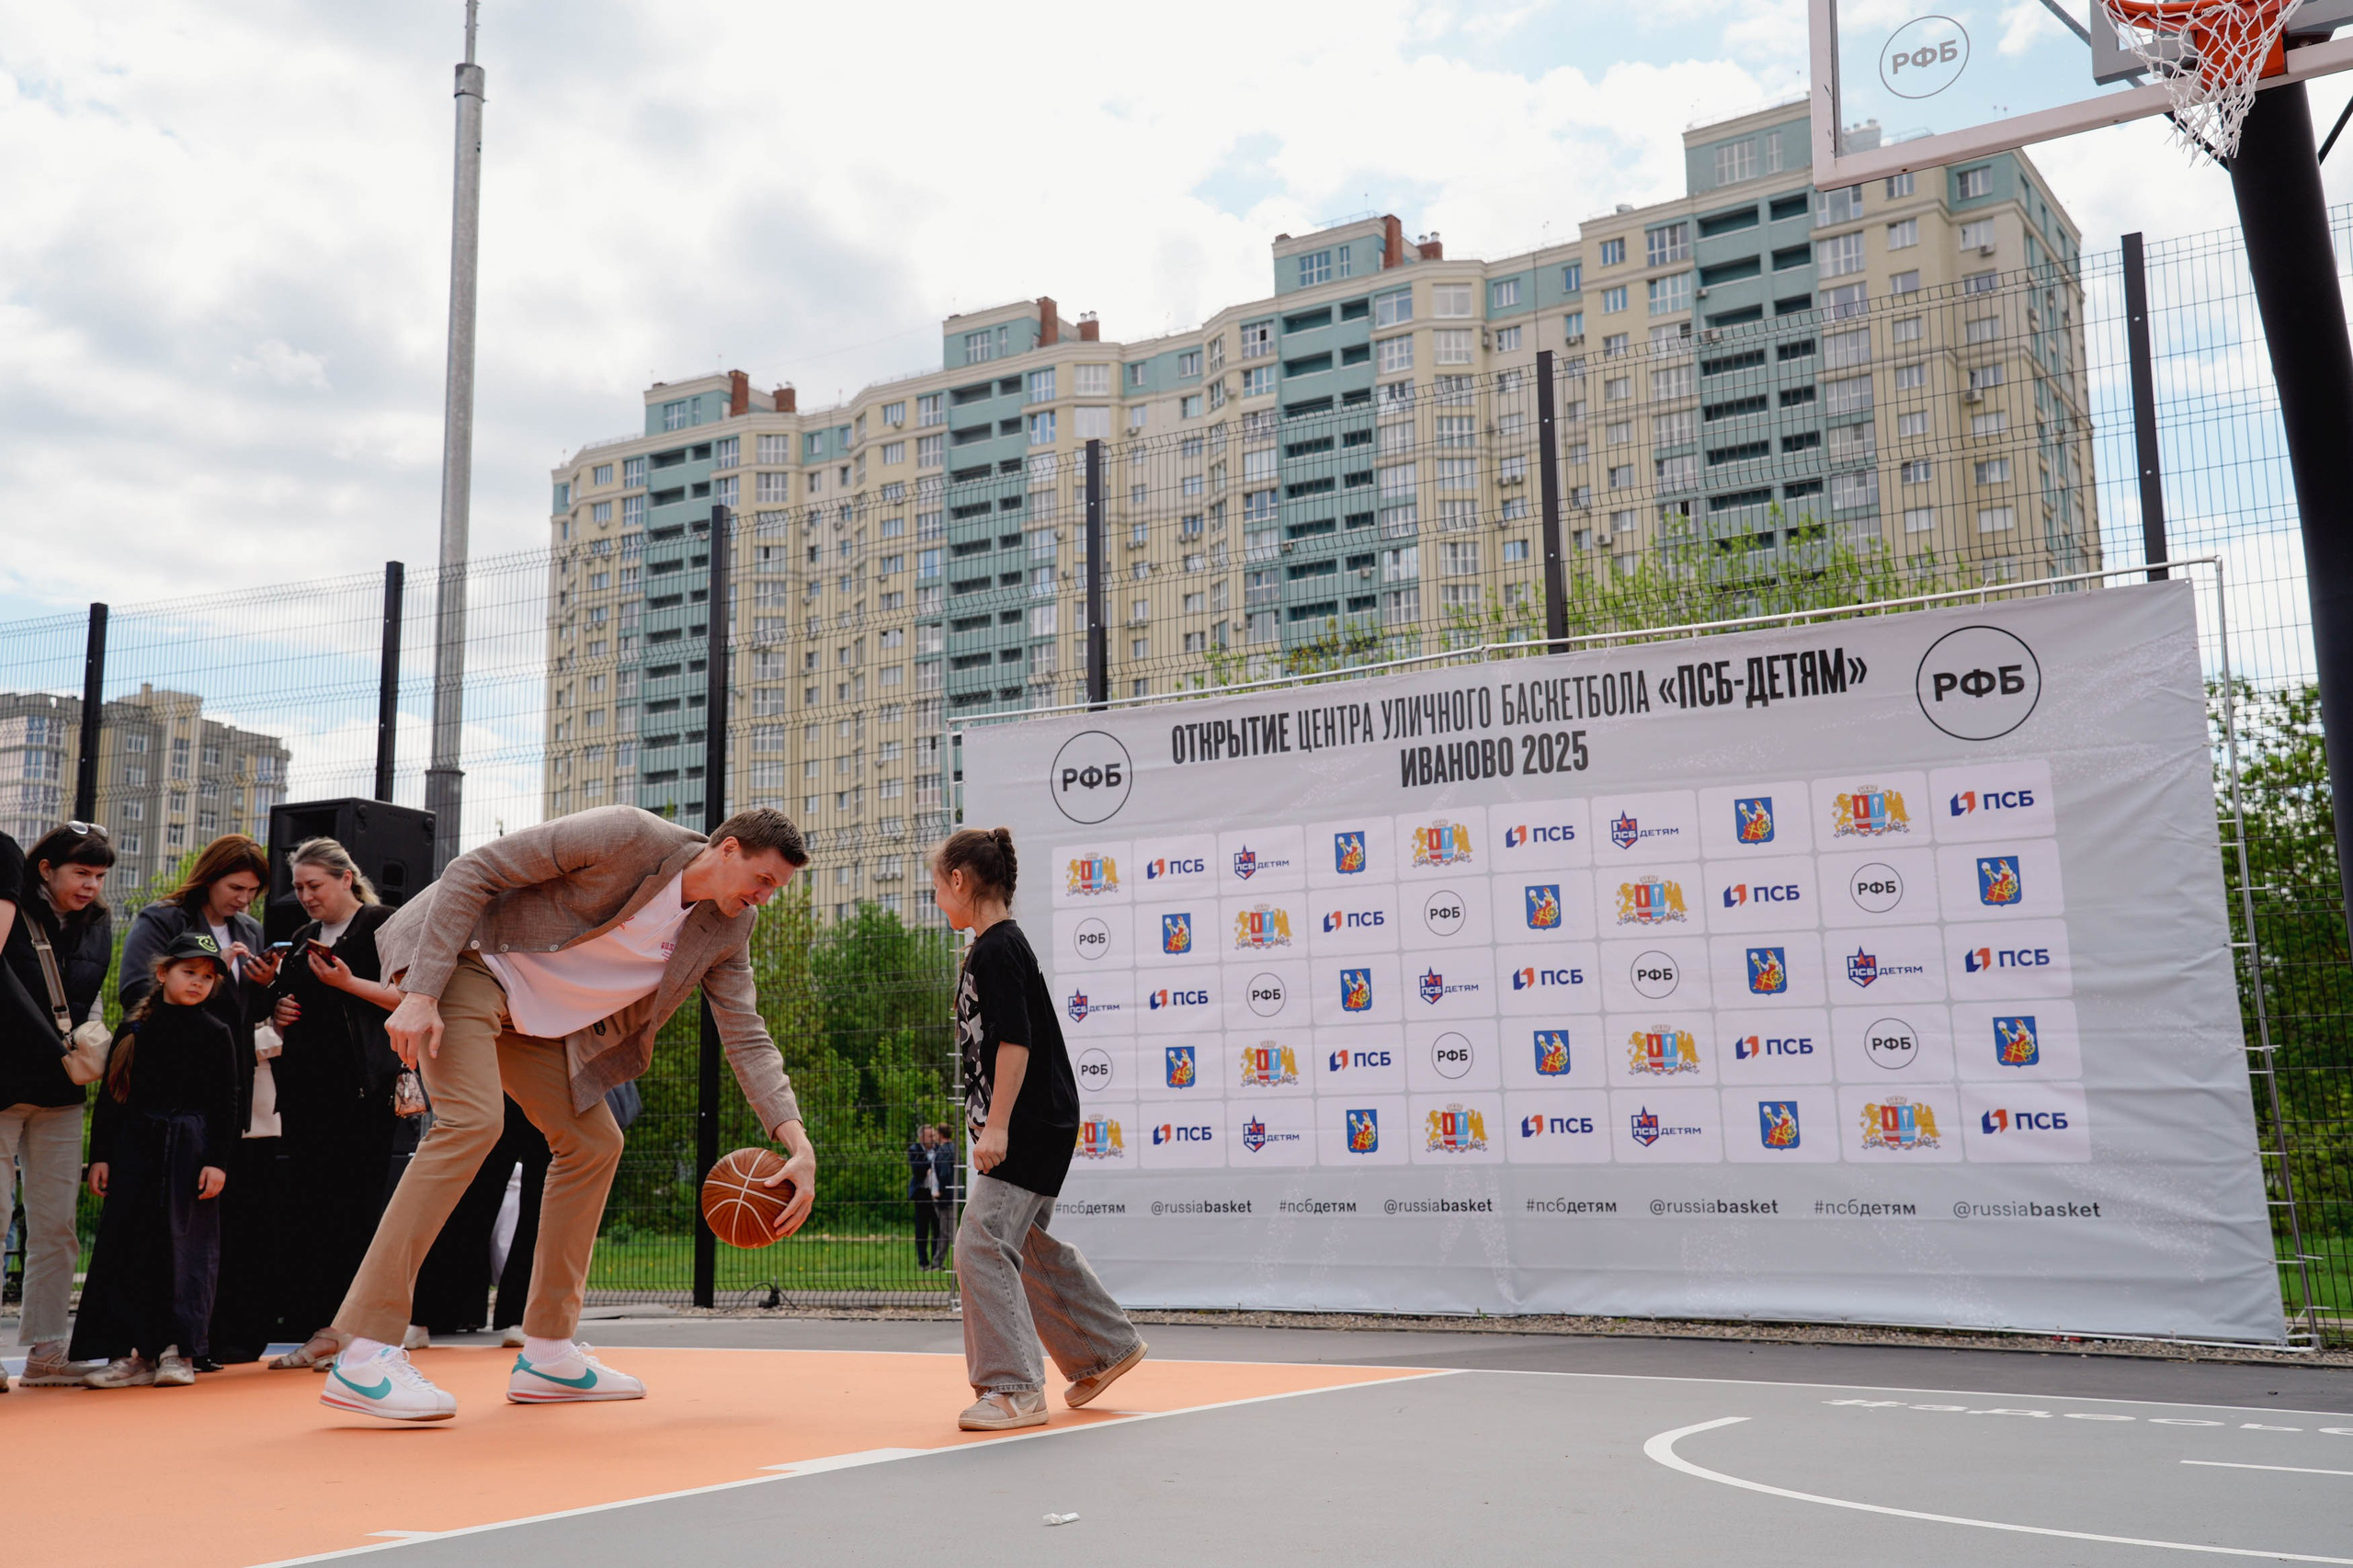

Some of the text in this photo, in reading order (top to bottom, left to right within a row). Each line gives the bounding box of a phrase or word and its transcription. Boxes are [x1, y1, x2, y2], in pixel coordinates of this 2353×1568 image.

[1892, 40, 1958, 74] РФБ
[1933, 665, 2024, 701] РФБ
[1172, 648, 1867, 764] ОТКРЫТИЕ ЦЕНТРА УЛИЧНОГО БАСКЕТБОЛА «ПСБ-ДЕТЯМ»
[1401, 731, 1588, 788] ИВАНОВО 2025
[1063, 763, 1121, 791] РФБ
[1984, 790, 2034, 810] ПСБ
[1533, 825, 1574, 842] ПСБ
[1640, 828, 1679, 837] ДЕТЯМ
[1170, 859, 1204, 874] ПСБ
[1257, 860, 1290, 869] ДЕТЯМ
[1754, 885, 1800, 902] ПСБ
[1858, 881, 1896, 894] РФБ
[1348, 912, 1384, 927] ПСБ
[1430, 907, 1460, 919] РФБ
[1080, 933, 1106, 945] РФБ
[1999, 949, 2050, 967] ПСБ
[1541, 970, 1583, 985] ПСБ
[1638, 969, 1673, 981] РФБ
[1880, 966, 1923, 975] ДЕТЯМ
[1253, 989, 1280, 1001] РФБ
[1444, 984, 1478, 994] ДЕТЯМ
[1174, 991, 1208, 1006] ПСБ
[1089, 1005, 1120, 1013] ДЕТЯМ
[1767, 1039, 1813, 1055] ПСБ
[1872, 1038, 1911, 1051] РФБ
[1355, 1051, 1391, 1067] ПСБ
[1438, 1050, 1468, 1062] РФБ
[1082, 1064, 1108, 1075] РФБ
[1551, 1118, 1593, 1133] ПСБ
[2016, 1113, 2068, 1130] ПСБ
[1176, 1127, 1211, 1141] ПСБ
[1267, 1134, 1300, 1142] ДЕТЯМ
[1661, 1128, 1701, 1136] ДЕТЯМ
[1152, 1200, 1251, 1215] @russiabasket
[1280, 1199, 1356, 1214] #псбдетям
[1384, 1199, 1492, 1214] @russiabasket
[1527, 1198, 1617, 1214] #псбдетям
[1650, 1199, 1779, 1215] @russiabasket
[1815, 1199, 1915, 1217] #псбдетям
[1953, 1201, 2101, 1218] @russiabasket
